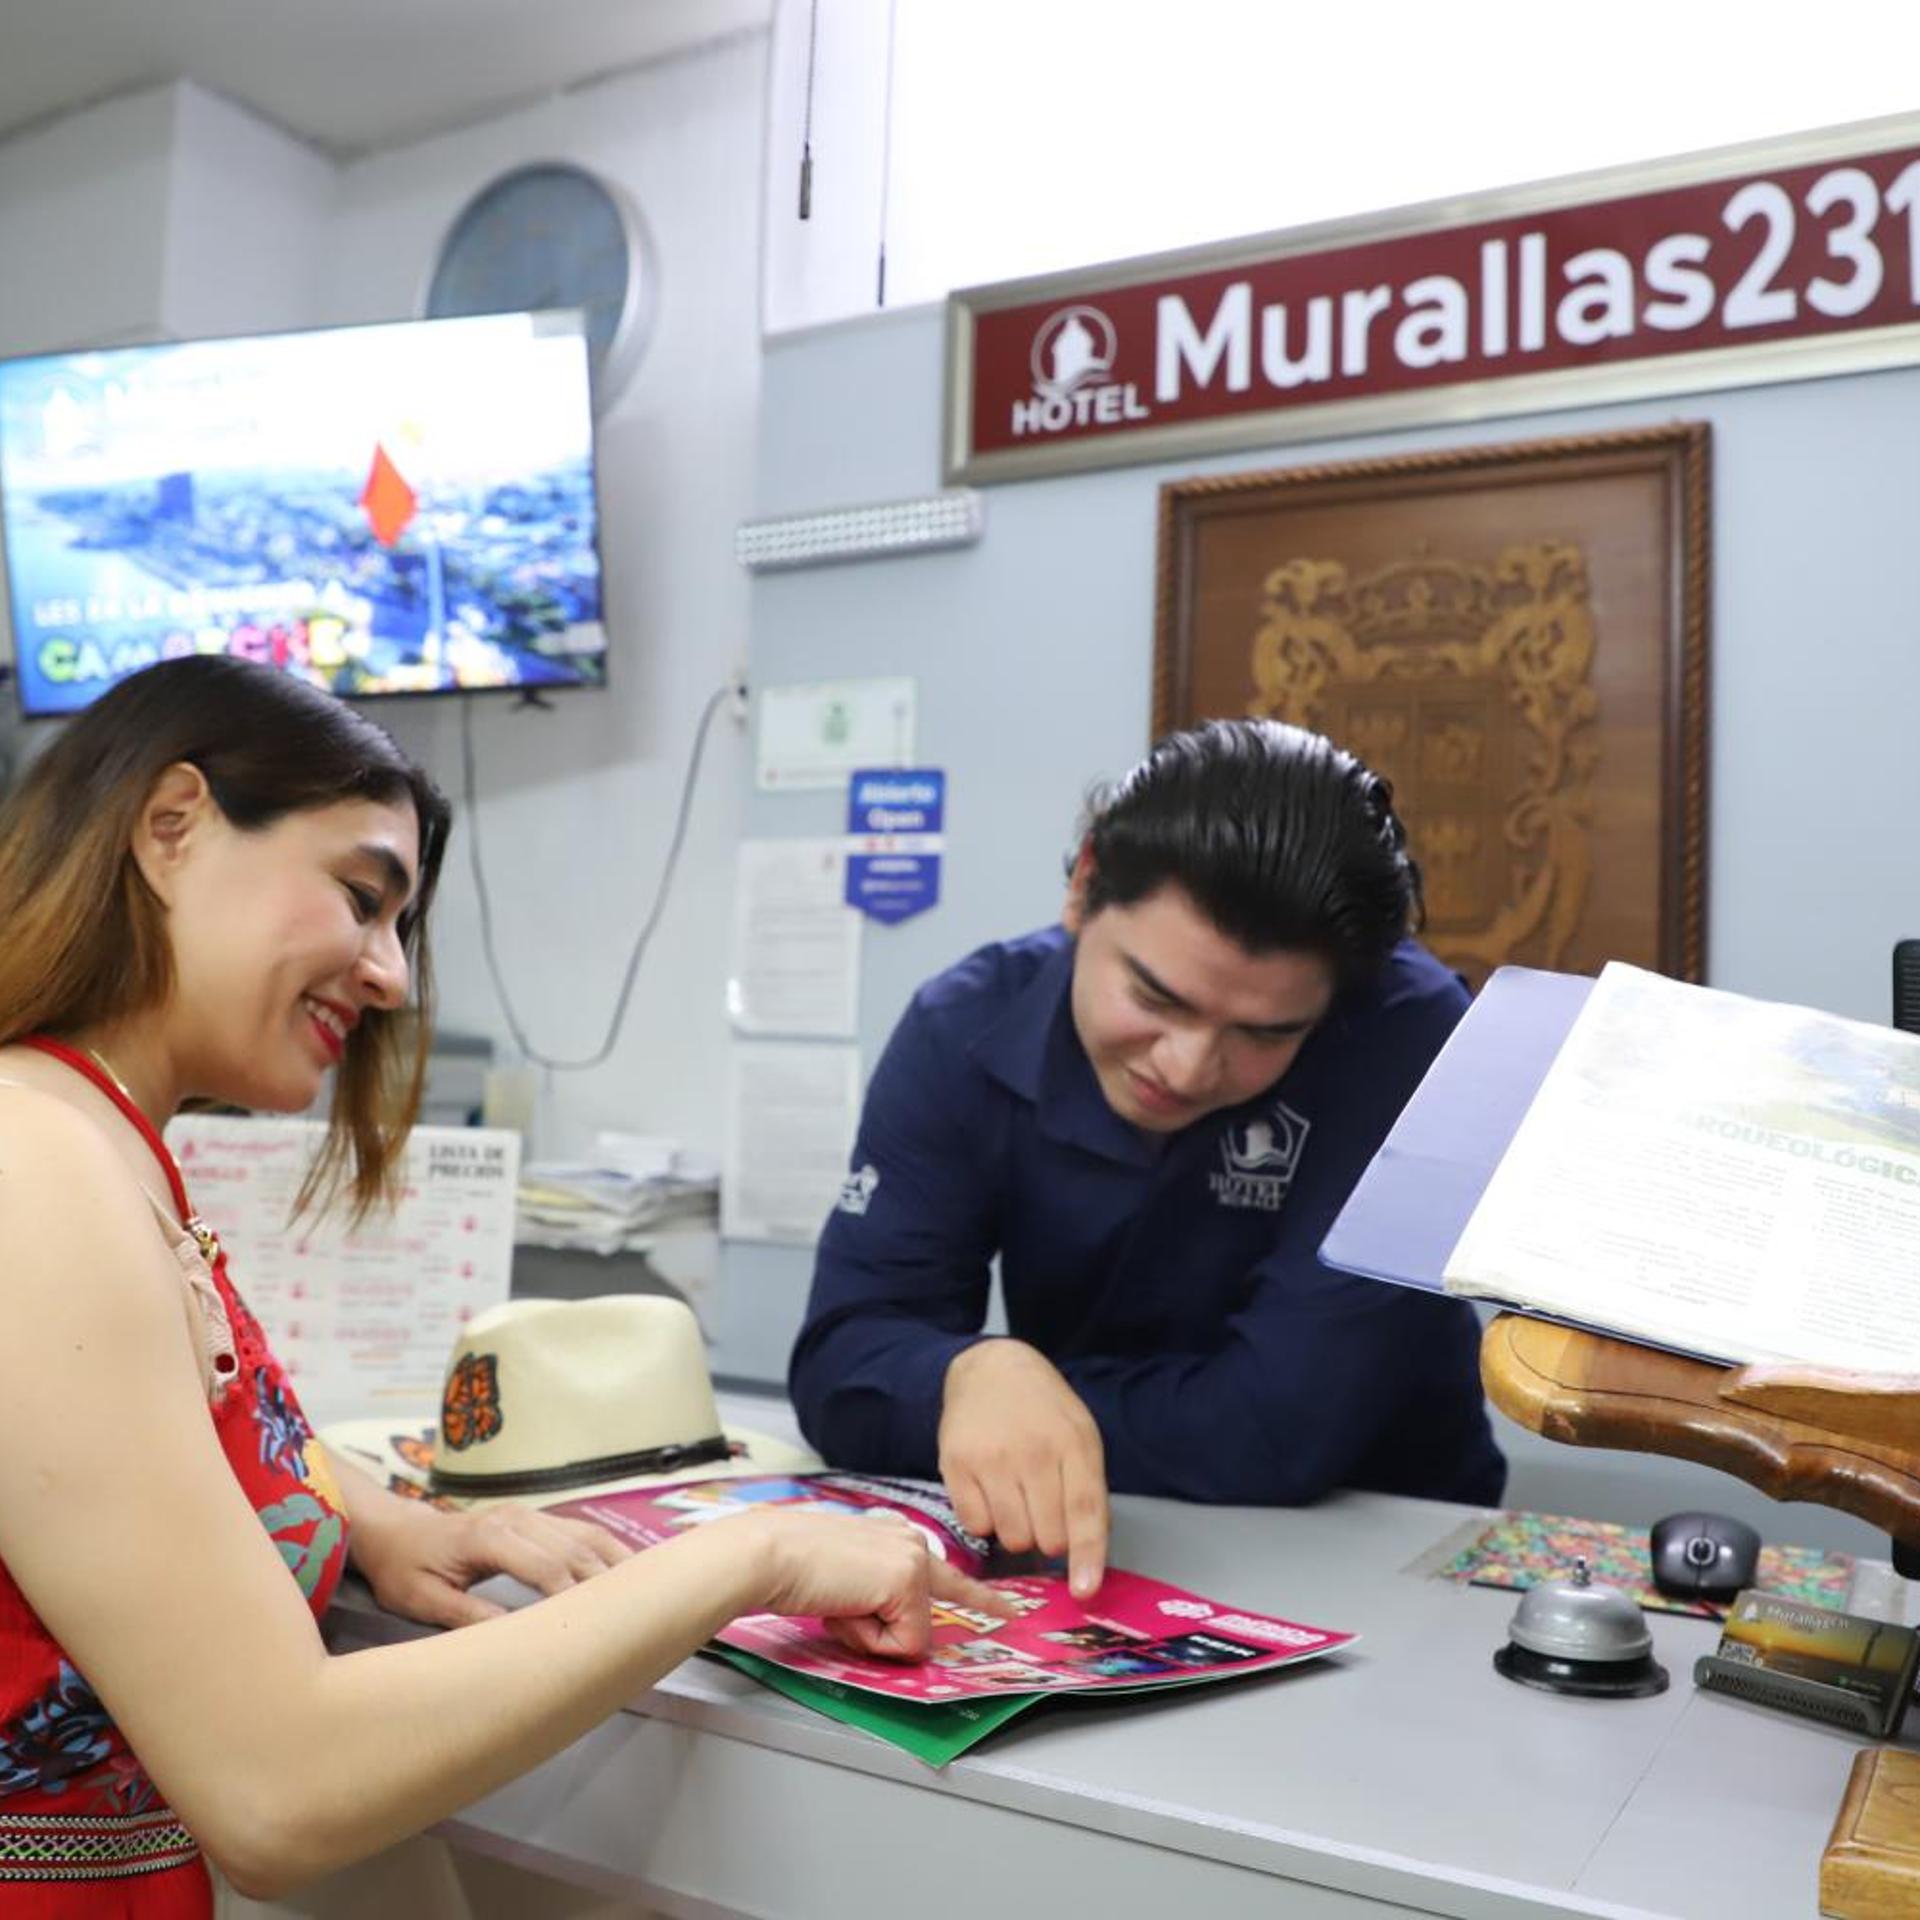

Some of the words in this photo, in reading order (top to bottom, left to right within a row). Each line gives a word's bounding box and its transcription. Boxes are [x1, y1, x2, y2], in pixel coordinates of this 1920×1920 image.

[1011, 383, 1149, 435] HOTEL
[1672, 1108, 1920, 1187] ARQUEOLÓGIC
[1209, 1171, 1287, 1201] HOTEL
